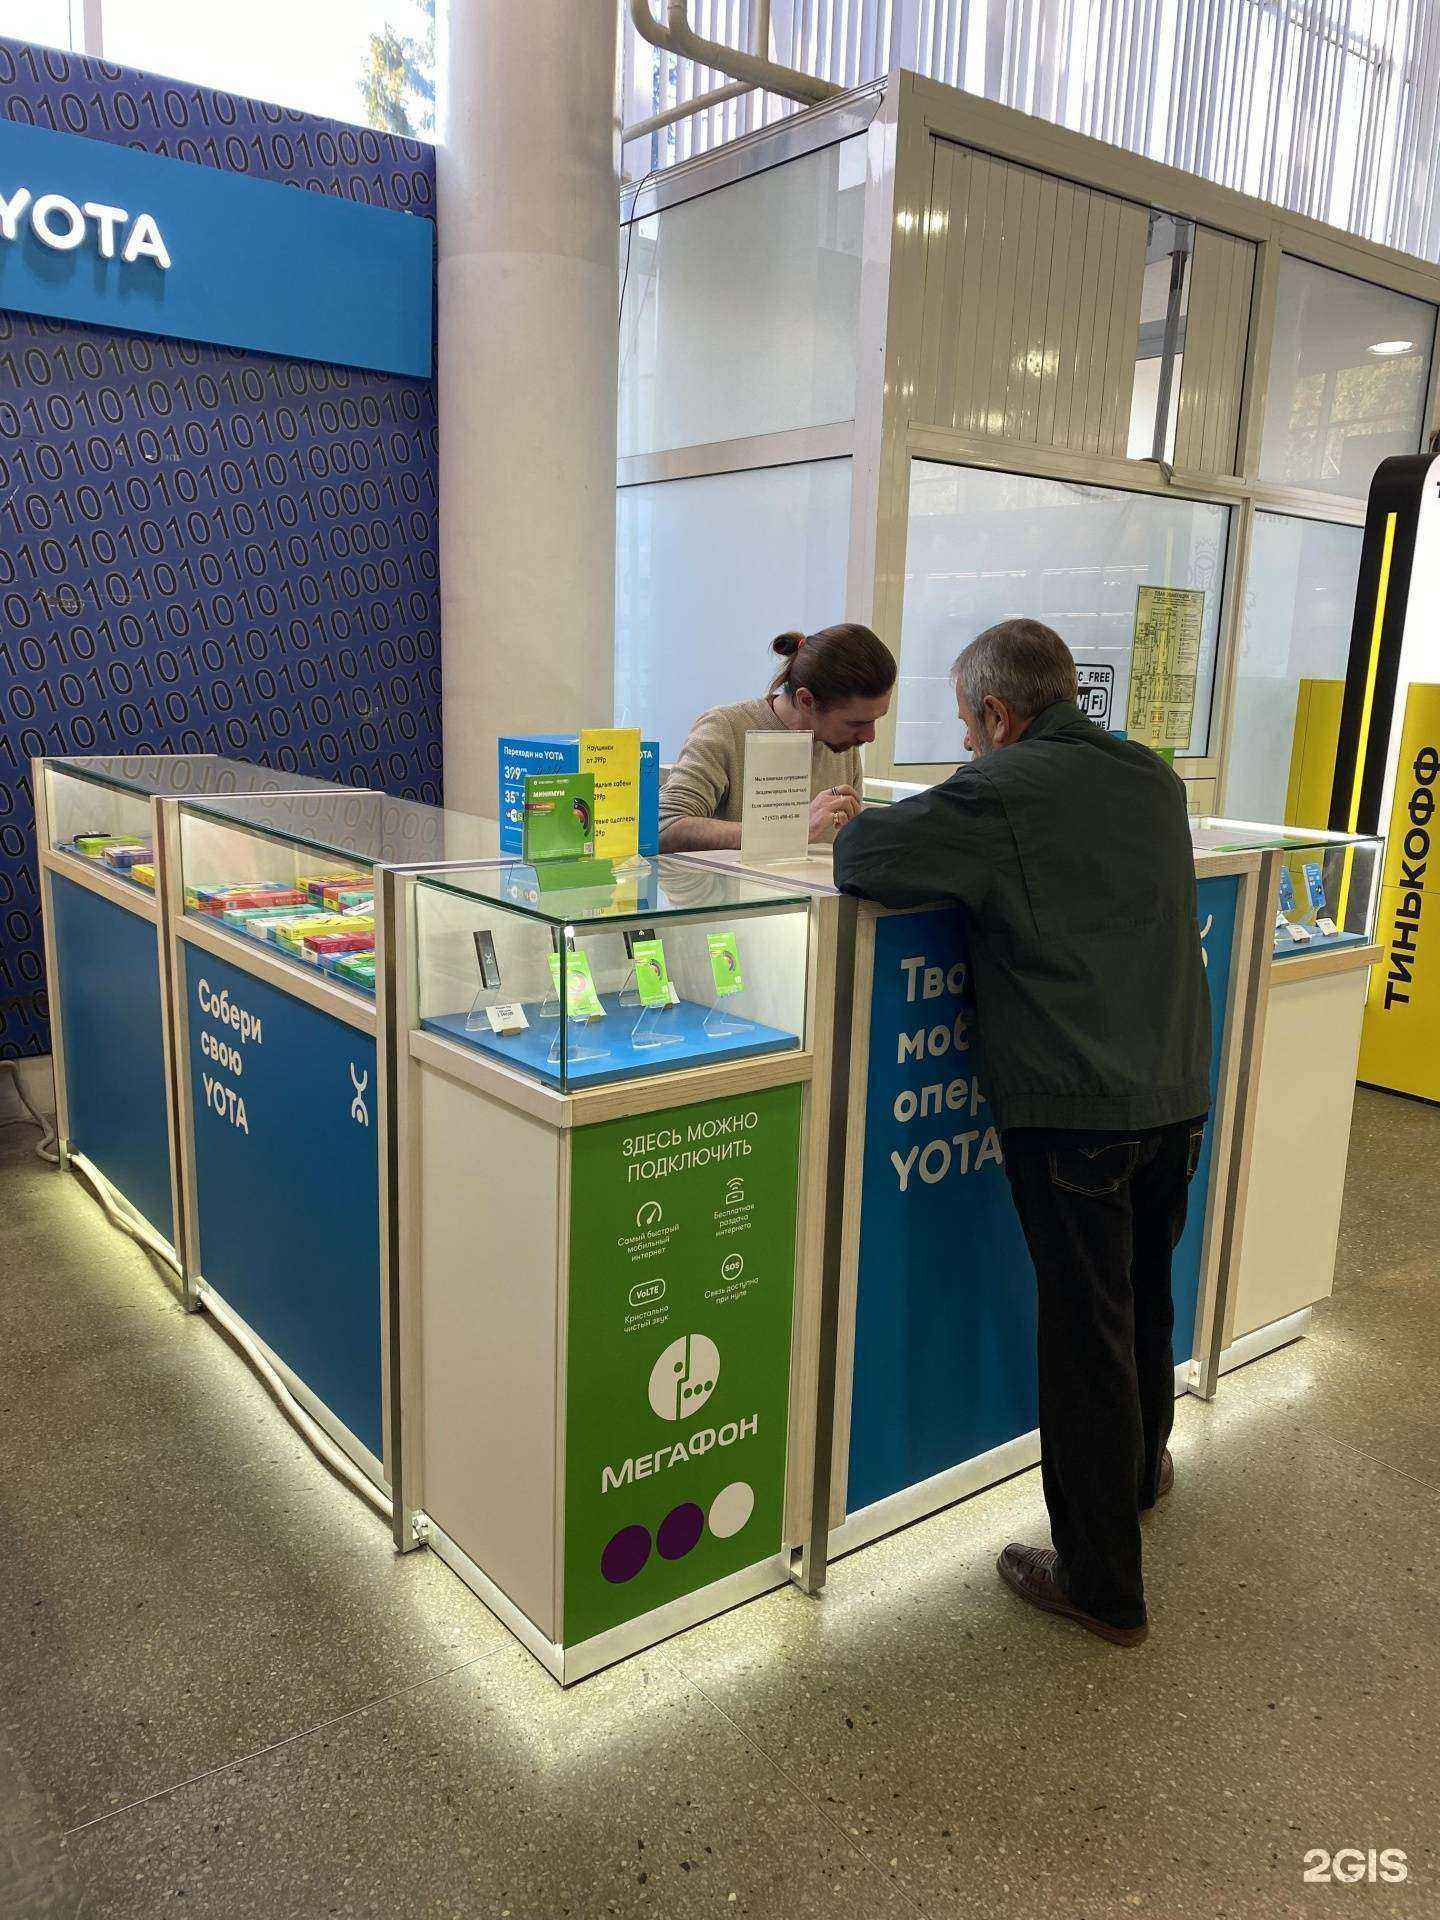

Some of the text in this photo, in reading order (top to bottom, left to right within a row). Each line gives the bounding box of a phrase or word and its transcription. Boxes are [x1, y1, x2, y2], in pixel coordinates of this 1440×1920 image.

[0, 187, 172, 270] YOTA
[1077, 671, 1111, 684] C_FREE
[503, 746, 564, 761] Переходи на YOTA
[504, 765, 521, 781] 399
[532, 790, 565, 798] МИНИМУМ
[1384, 746, 1440, 1010] ТИНЬКОФФ
[900, 956, 968, 1002] Тво
[198, 978, 262, 1044] Собери
[897, 1009, 972, 1064] моб
[201, 1031, 242, 1076] свою
[203, 1072, 249, 1135] YOTA
[893, 1075, 987, 1123] опер
[622, 1112, 758, 1157] ЗДЕСЬ МОЖНО
[628, 1140, 752, 1183] ПОДКЛЮЧИТЬ
[890, 1126, 1003, 1192] YOTA
[713, 1203, 756, 1220] Бесплатная
[715, 1222, 752, 1238] интернета
[719, 1214, 749, 1229] раздача
[617, 1223, 680, 1247] Самый быстрый
[627, 1236, 670, 1254] мобильный
[631, 1246, 666, 1263] интернет
[724, 1261, 741, 1272] SOS
[636, 1285, 660, 1300] VoLTE
[704, 1288, 726, 1300] Связь
[716, 1295, 730, 1305] при
[624, 1305, 669, 1324] Кристально
[624, 1315, 670, 1333] чистый звук
[600, 1413, 758, 1494] МЕГАФОН
